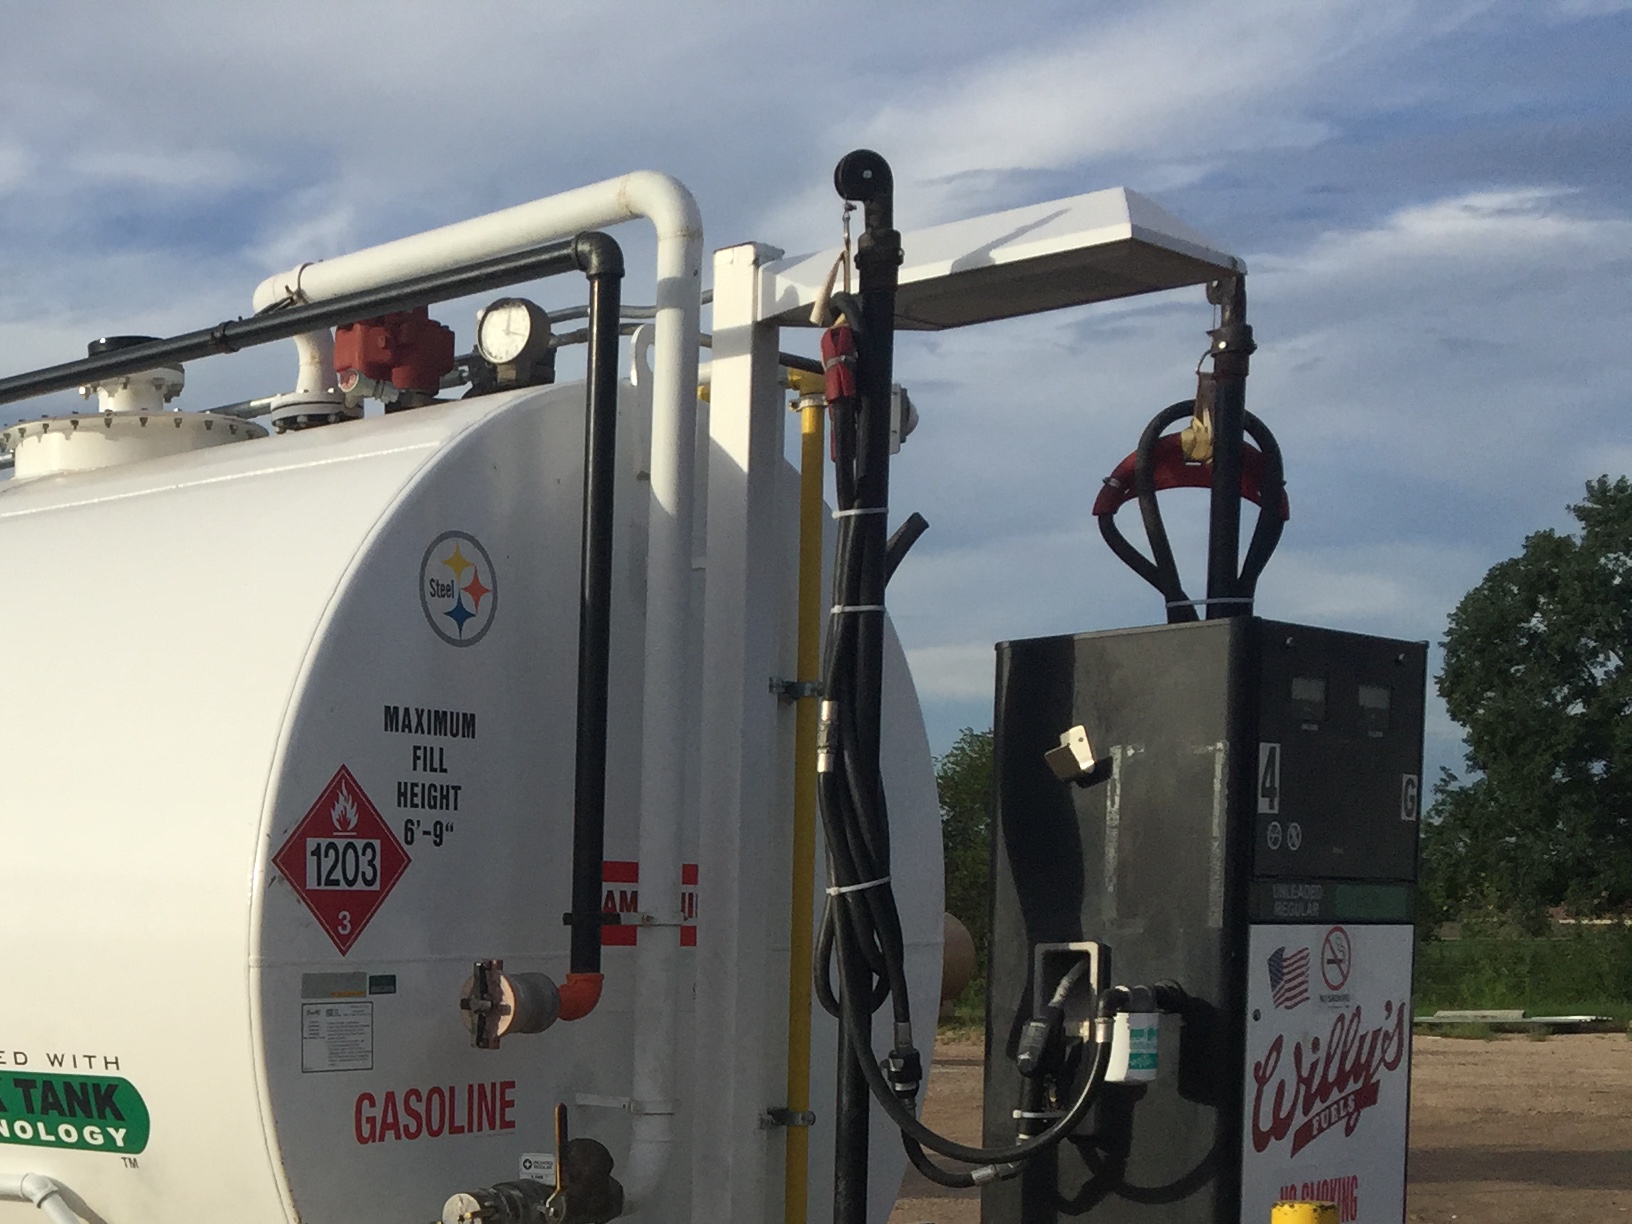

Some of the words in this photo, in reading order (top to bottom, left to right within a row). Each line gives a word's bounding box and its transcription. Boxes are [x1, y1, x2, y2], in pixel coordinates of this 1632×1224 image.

[429, 577, 455, 599] Steel
[384, 705, 476, 739] MAXIMUM
[412, 745, 448, 773] FILL
[1261, 746, 1277, 810] 4
[397, 781, 462, 811] HEIGHT
[1403, 777, 1417, 817] G
[310, 841, 378, 888] 1203
[337, 911, 352, 935] 3
[46, 1053, 120, 1071] WITH
[1252, 1000, 1406, 1153] Willy's
[13, 1077, 127, 1122] TANK
[354, 1080, 516, 1145] GASOLINE
[1311, 1093, 1356, 1136] FUELS
